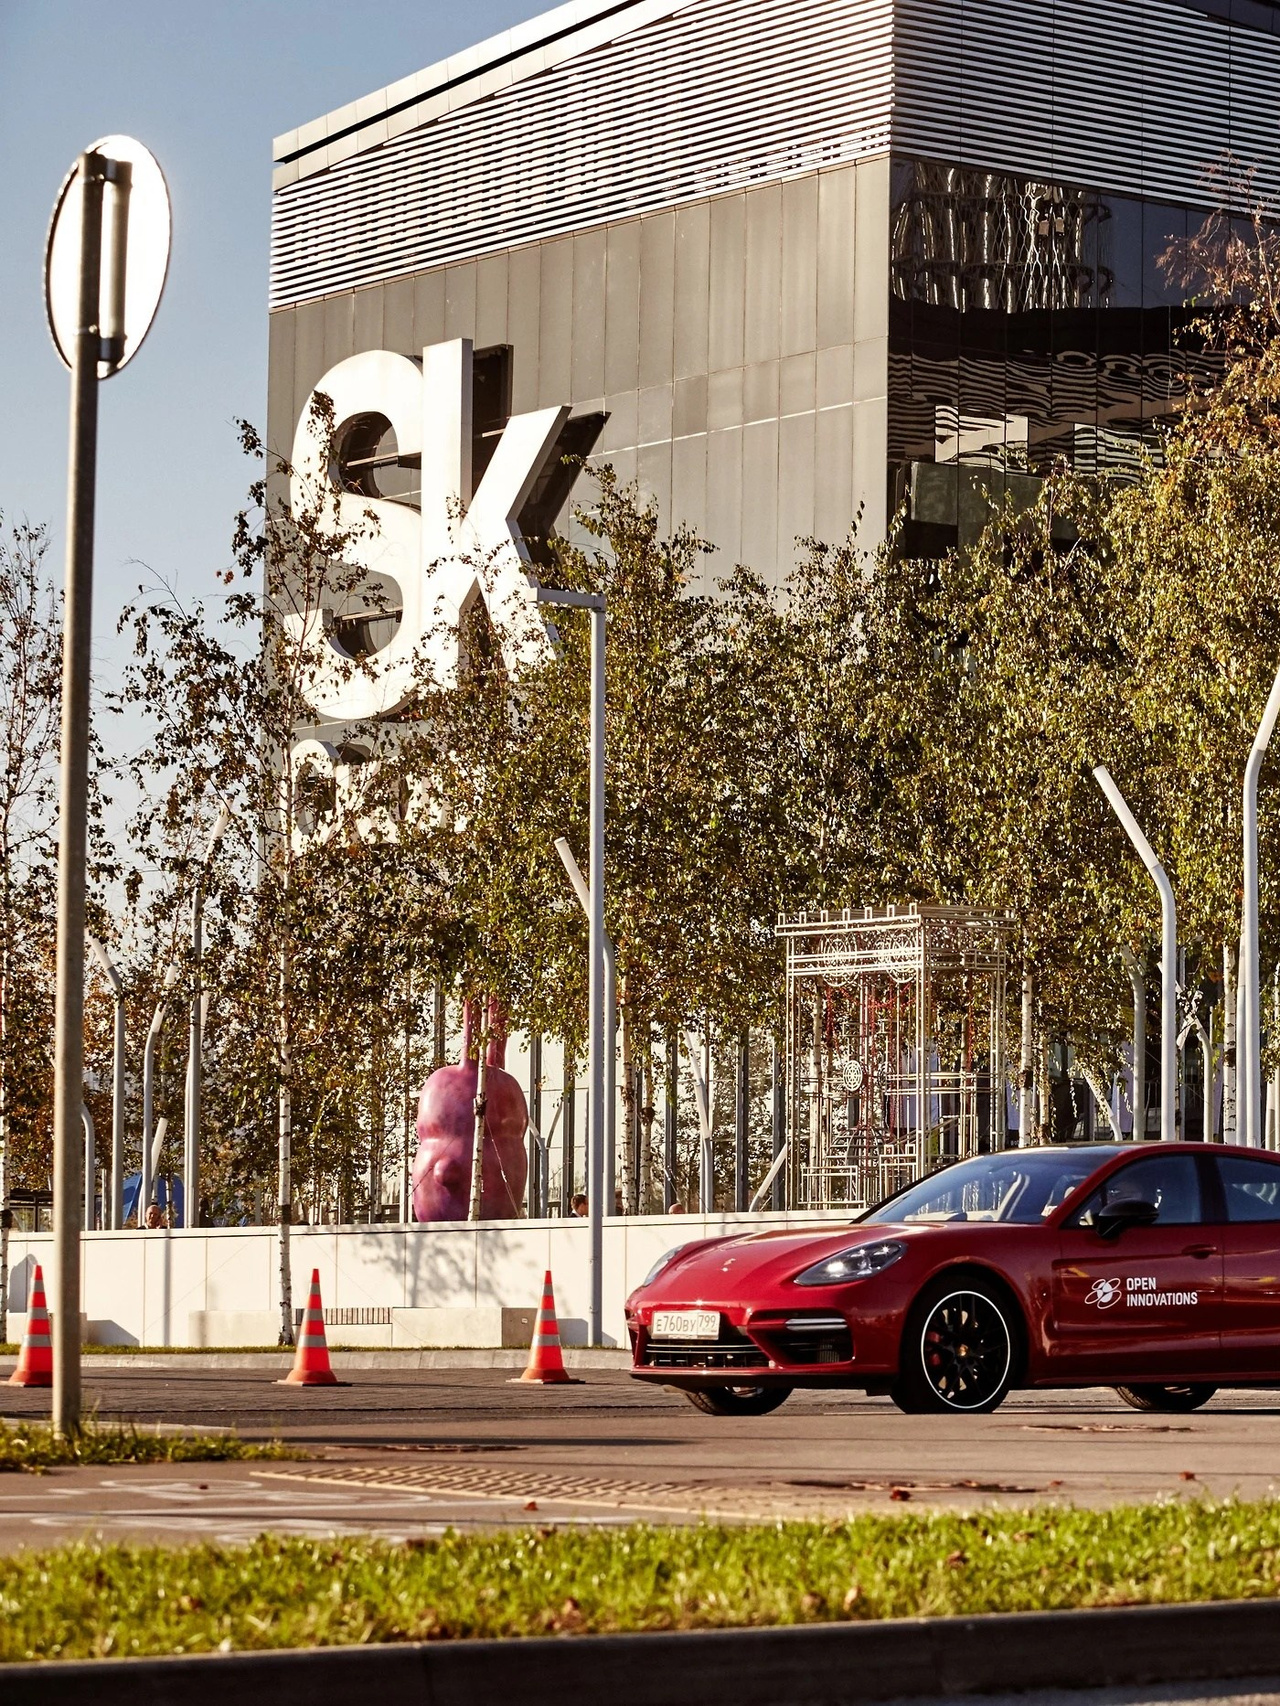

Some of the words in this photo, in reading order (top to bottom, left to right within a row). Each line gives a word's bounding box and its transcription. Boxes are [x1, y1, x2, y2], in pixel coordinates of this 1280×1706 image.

[283, 338, 572, 719] Sk
[1126, 1277, 1156, 1291] OPEN
[1126, 1291, 1198, 1307] INNOVATIONS
[698, 1314, 716, 1328] 799
